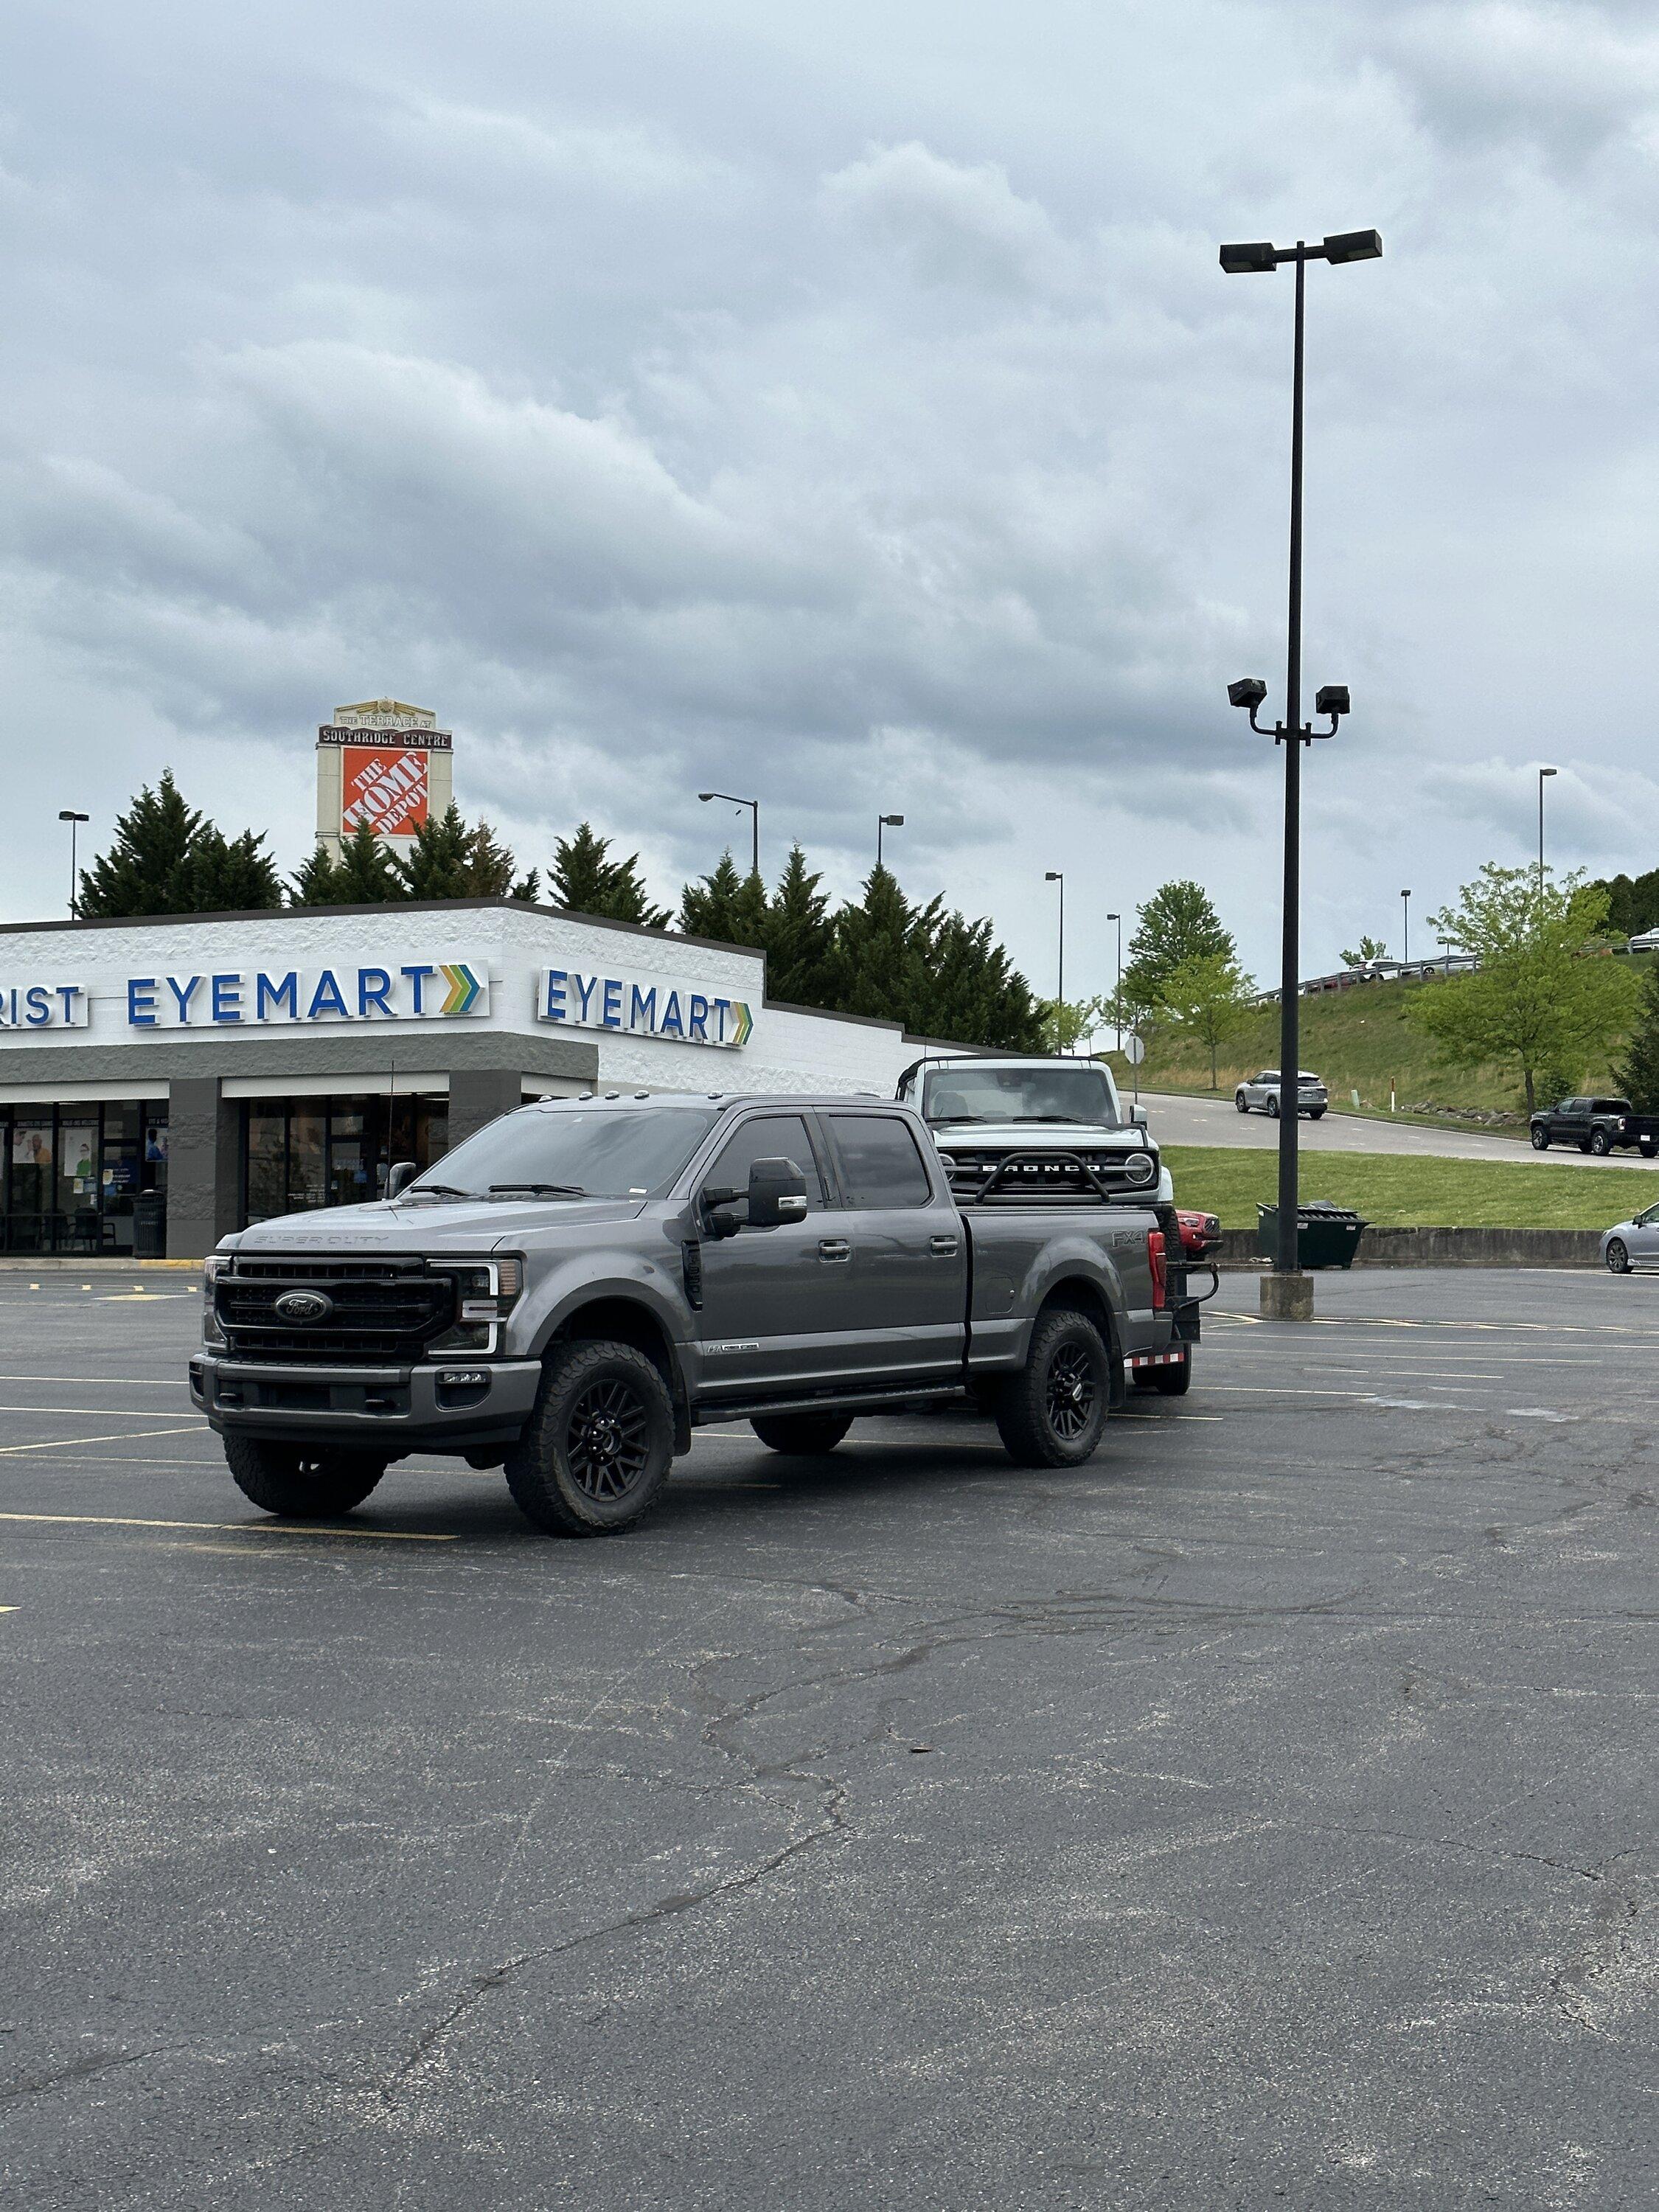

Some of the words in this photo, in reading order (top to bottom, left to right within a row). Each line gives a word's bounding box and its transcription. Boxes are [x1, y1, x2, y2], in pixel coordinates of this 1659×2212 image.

[322, 730, 396, 745] SOUTHRIDGE
[403, 734, 448, 747] CENTRE
[340, 716, 358, 725] THE
[359, 715, 418, 728] TERRACE
[419, 720, 431, 728] AT
[342, 751, 428, 827] HOME
[350, 757, 387, 792] THE
[375, 781, 428, 835] DEPOT
[0, 987, 80, 1025] IST
[128, 965, 434, 1025] EYEMART
[547, 970, 731, 1042] EYEMART
[254, 1235, 323, 1245] SUPER
[329, 1235, 389, 1245] DUTY
[1111, 1229, 1147, 1248] FX4
[285, 1298, 314, 1315] Ford
